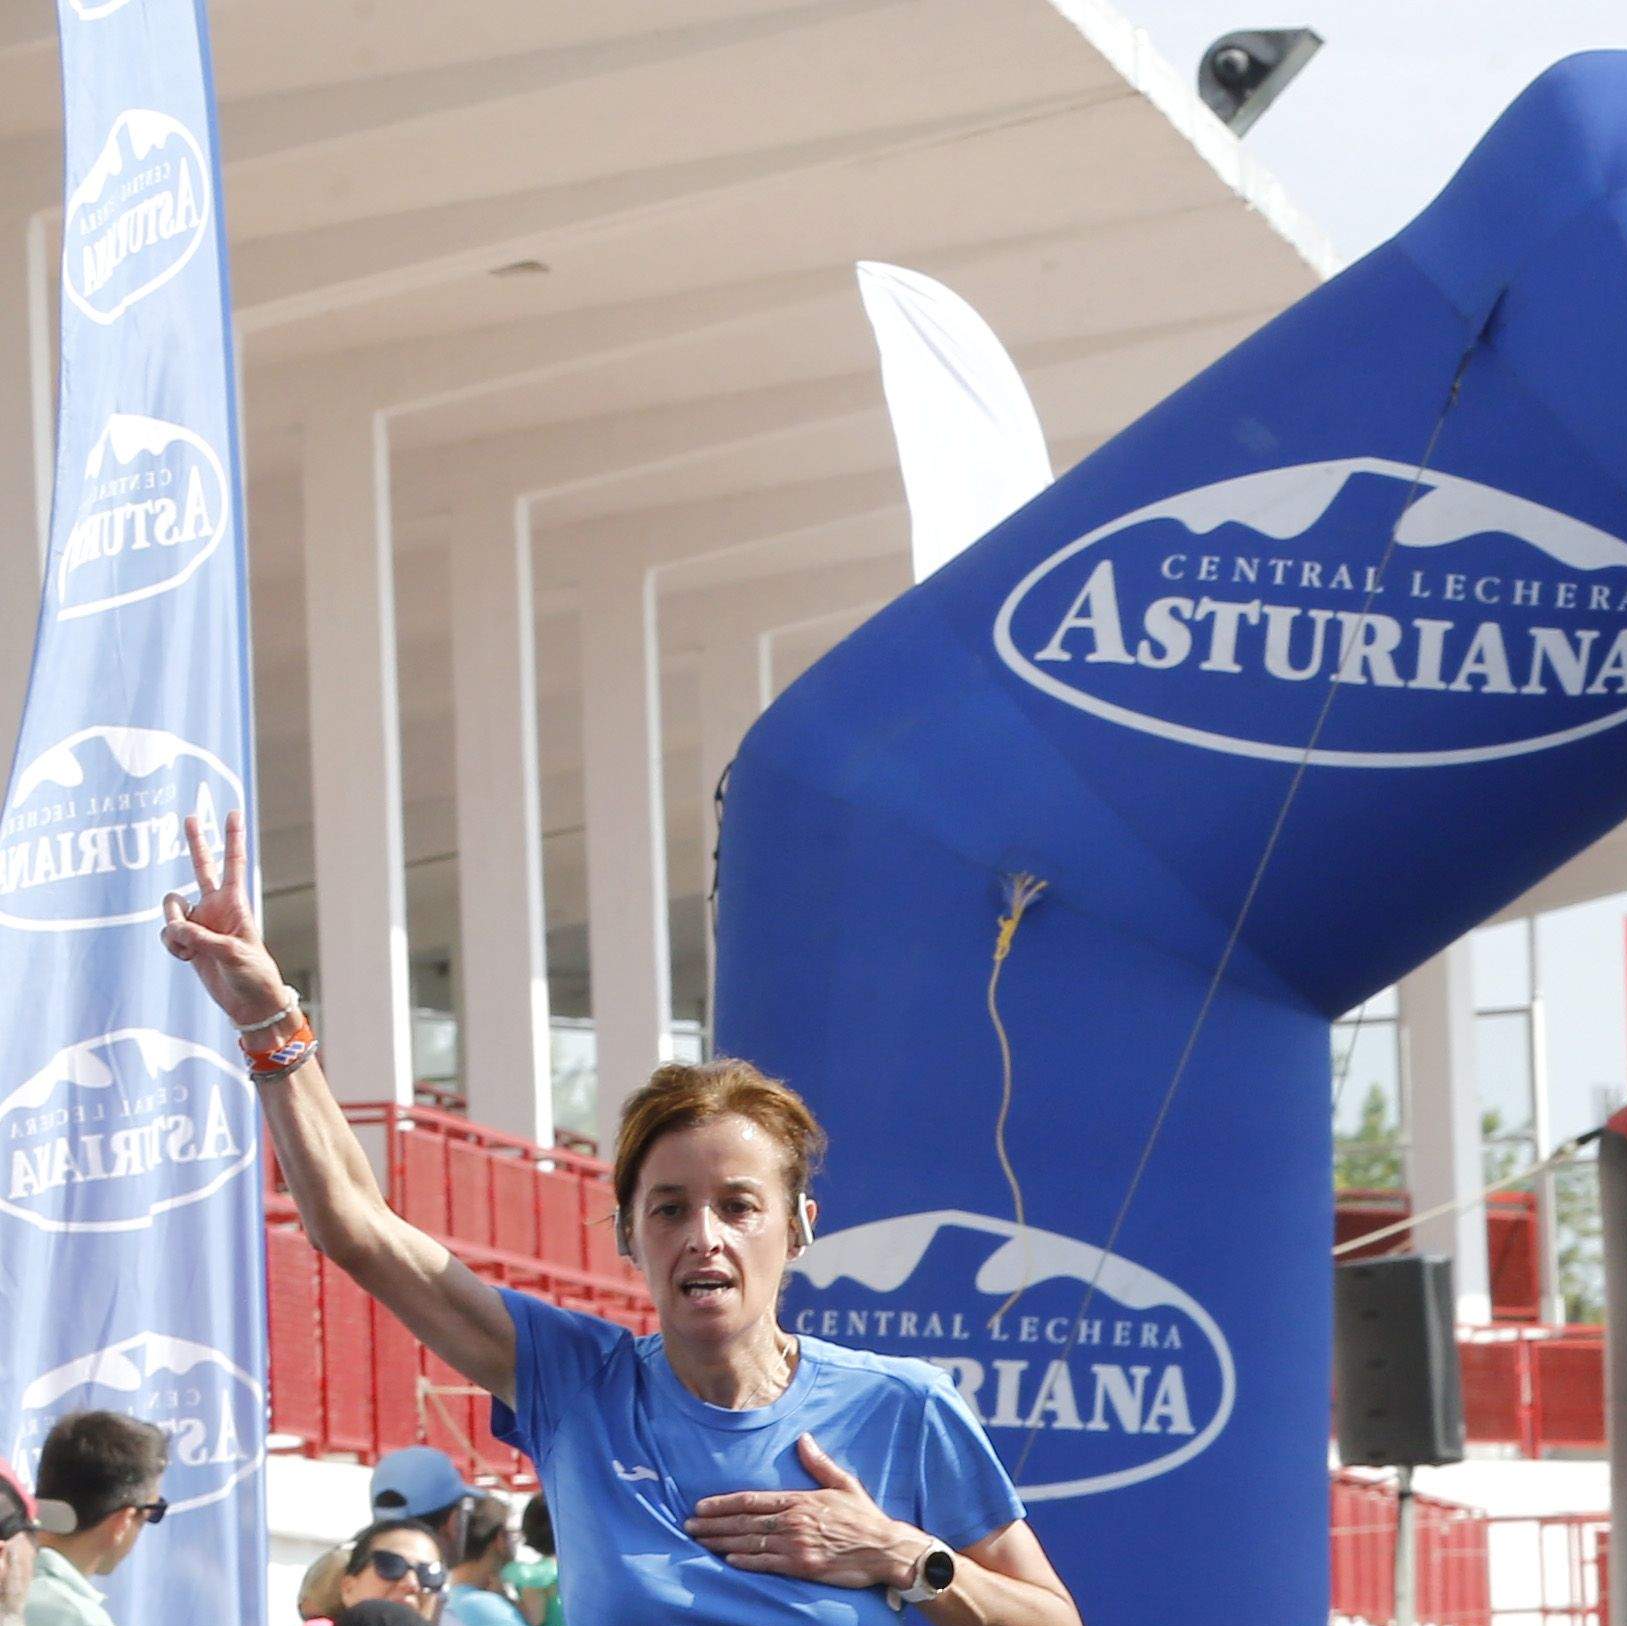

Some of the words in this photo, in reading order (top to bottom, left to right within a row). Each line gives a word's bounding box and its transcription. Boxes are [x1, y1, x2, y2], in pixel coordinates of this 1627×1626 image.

[1160, 553, 1386, 595] CENTRAL
[796, 1308, 971, 1341] CENTRAL
[992, 1315, 1185, 1350] LECHERA
[923, 1357, 1196, 1436] RIANA
